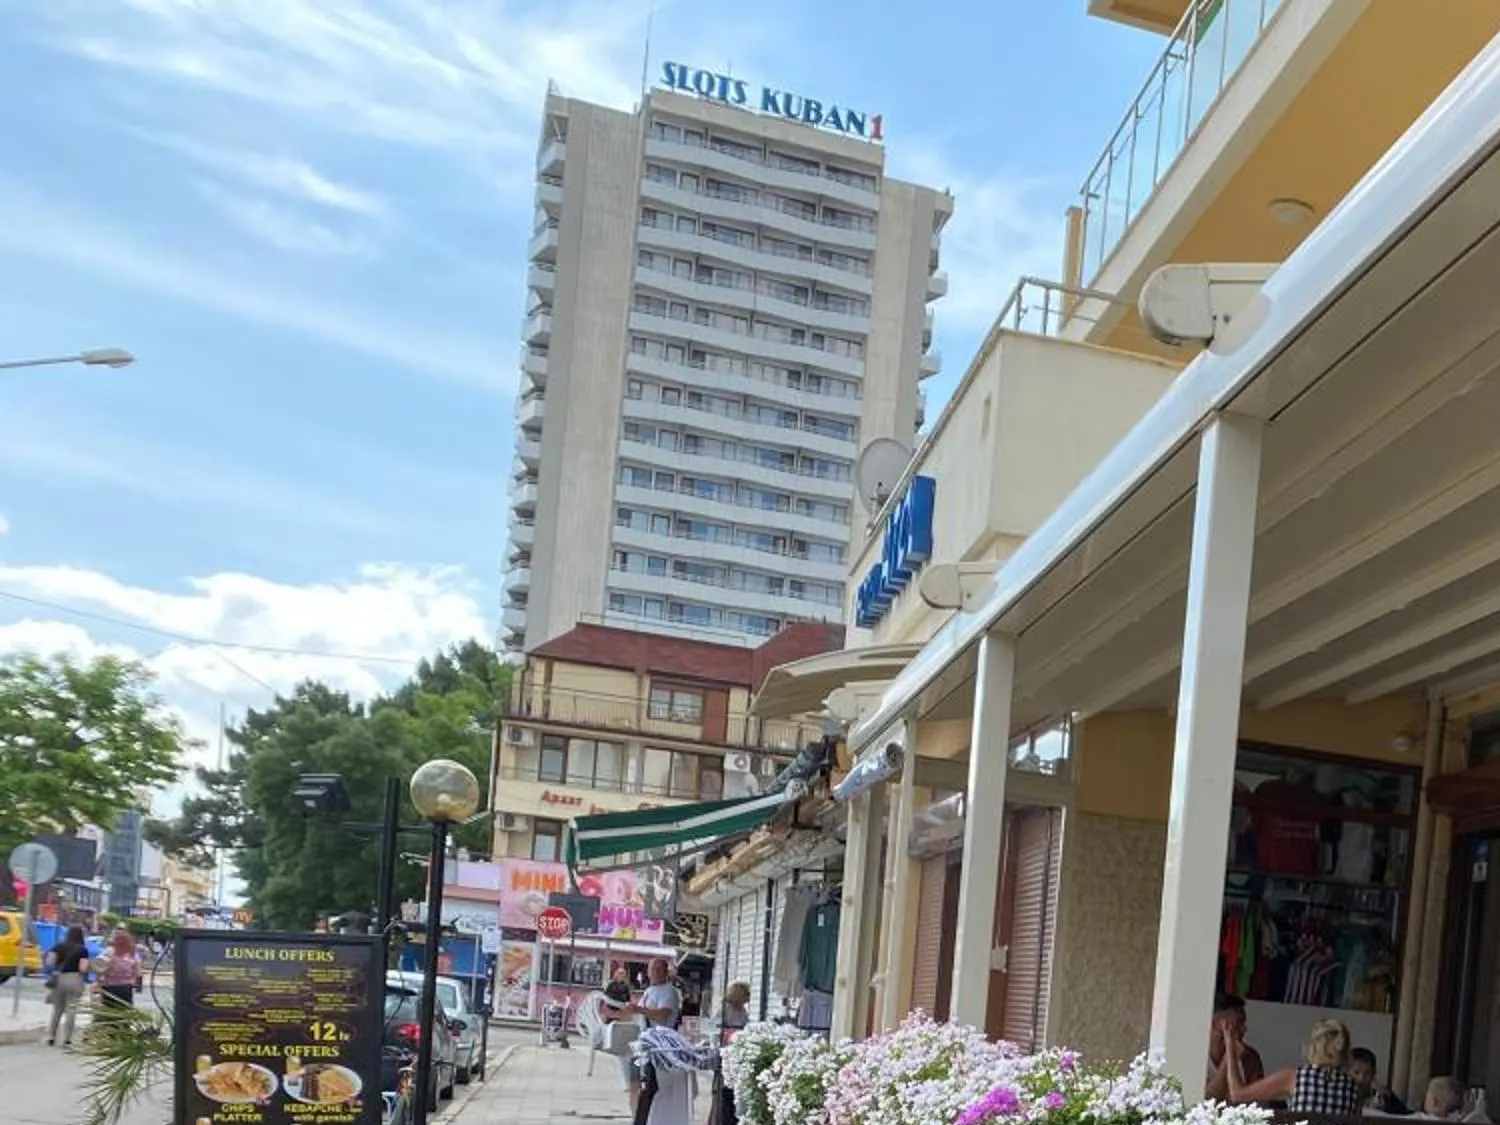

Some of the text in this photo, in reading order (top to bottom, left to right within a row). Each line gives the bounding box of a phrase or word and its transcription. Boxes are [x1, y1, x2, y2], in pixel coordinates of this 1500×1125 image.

[660, 61, 749, 104] SLOTS
[539, 916, 569, 930] STOP
[224, 947, 336, 962] LUNCH OFFERS
[309, 1022, 337, 1041] 12
[219, 1043, 340, 1058] SPECIAL OFFERS
[221, 1104, 256, 1113] CHIPS
[213, 1113, 263, 1122] PLATTER
